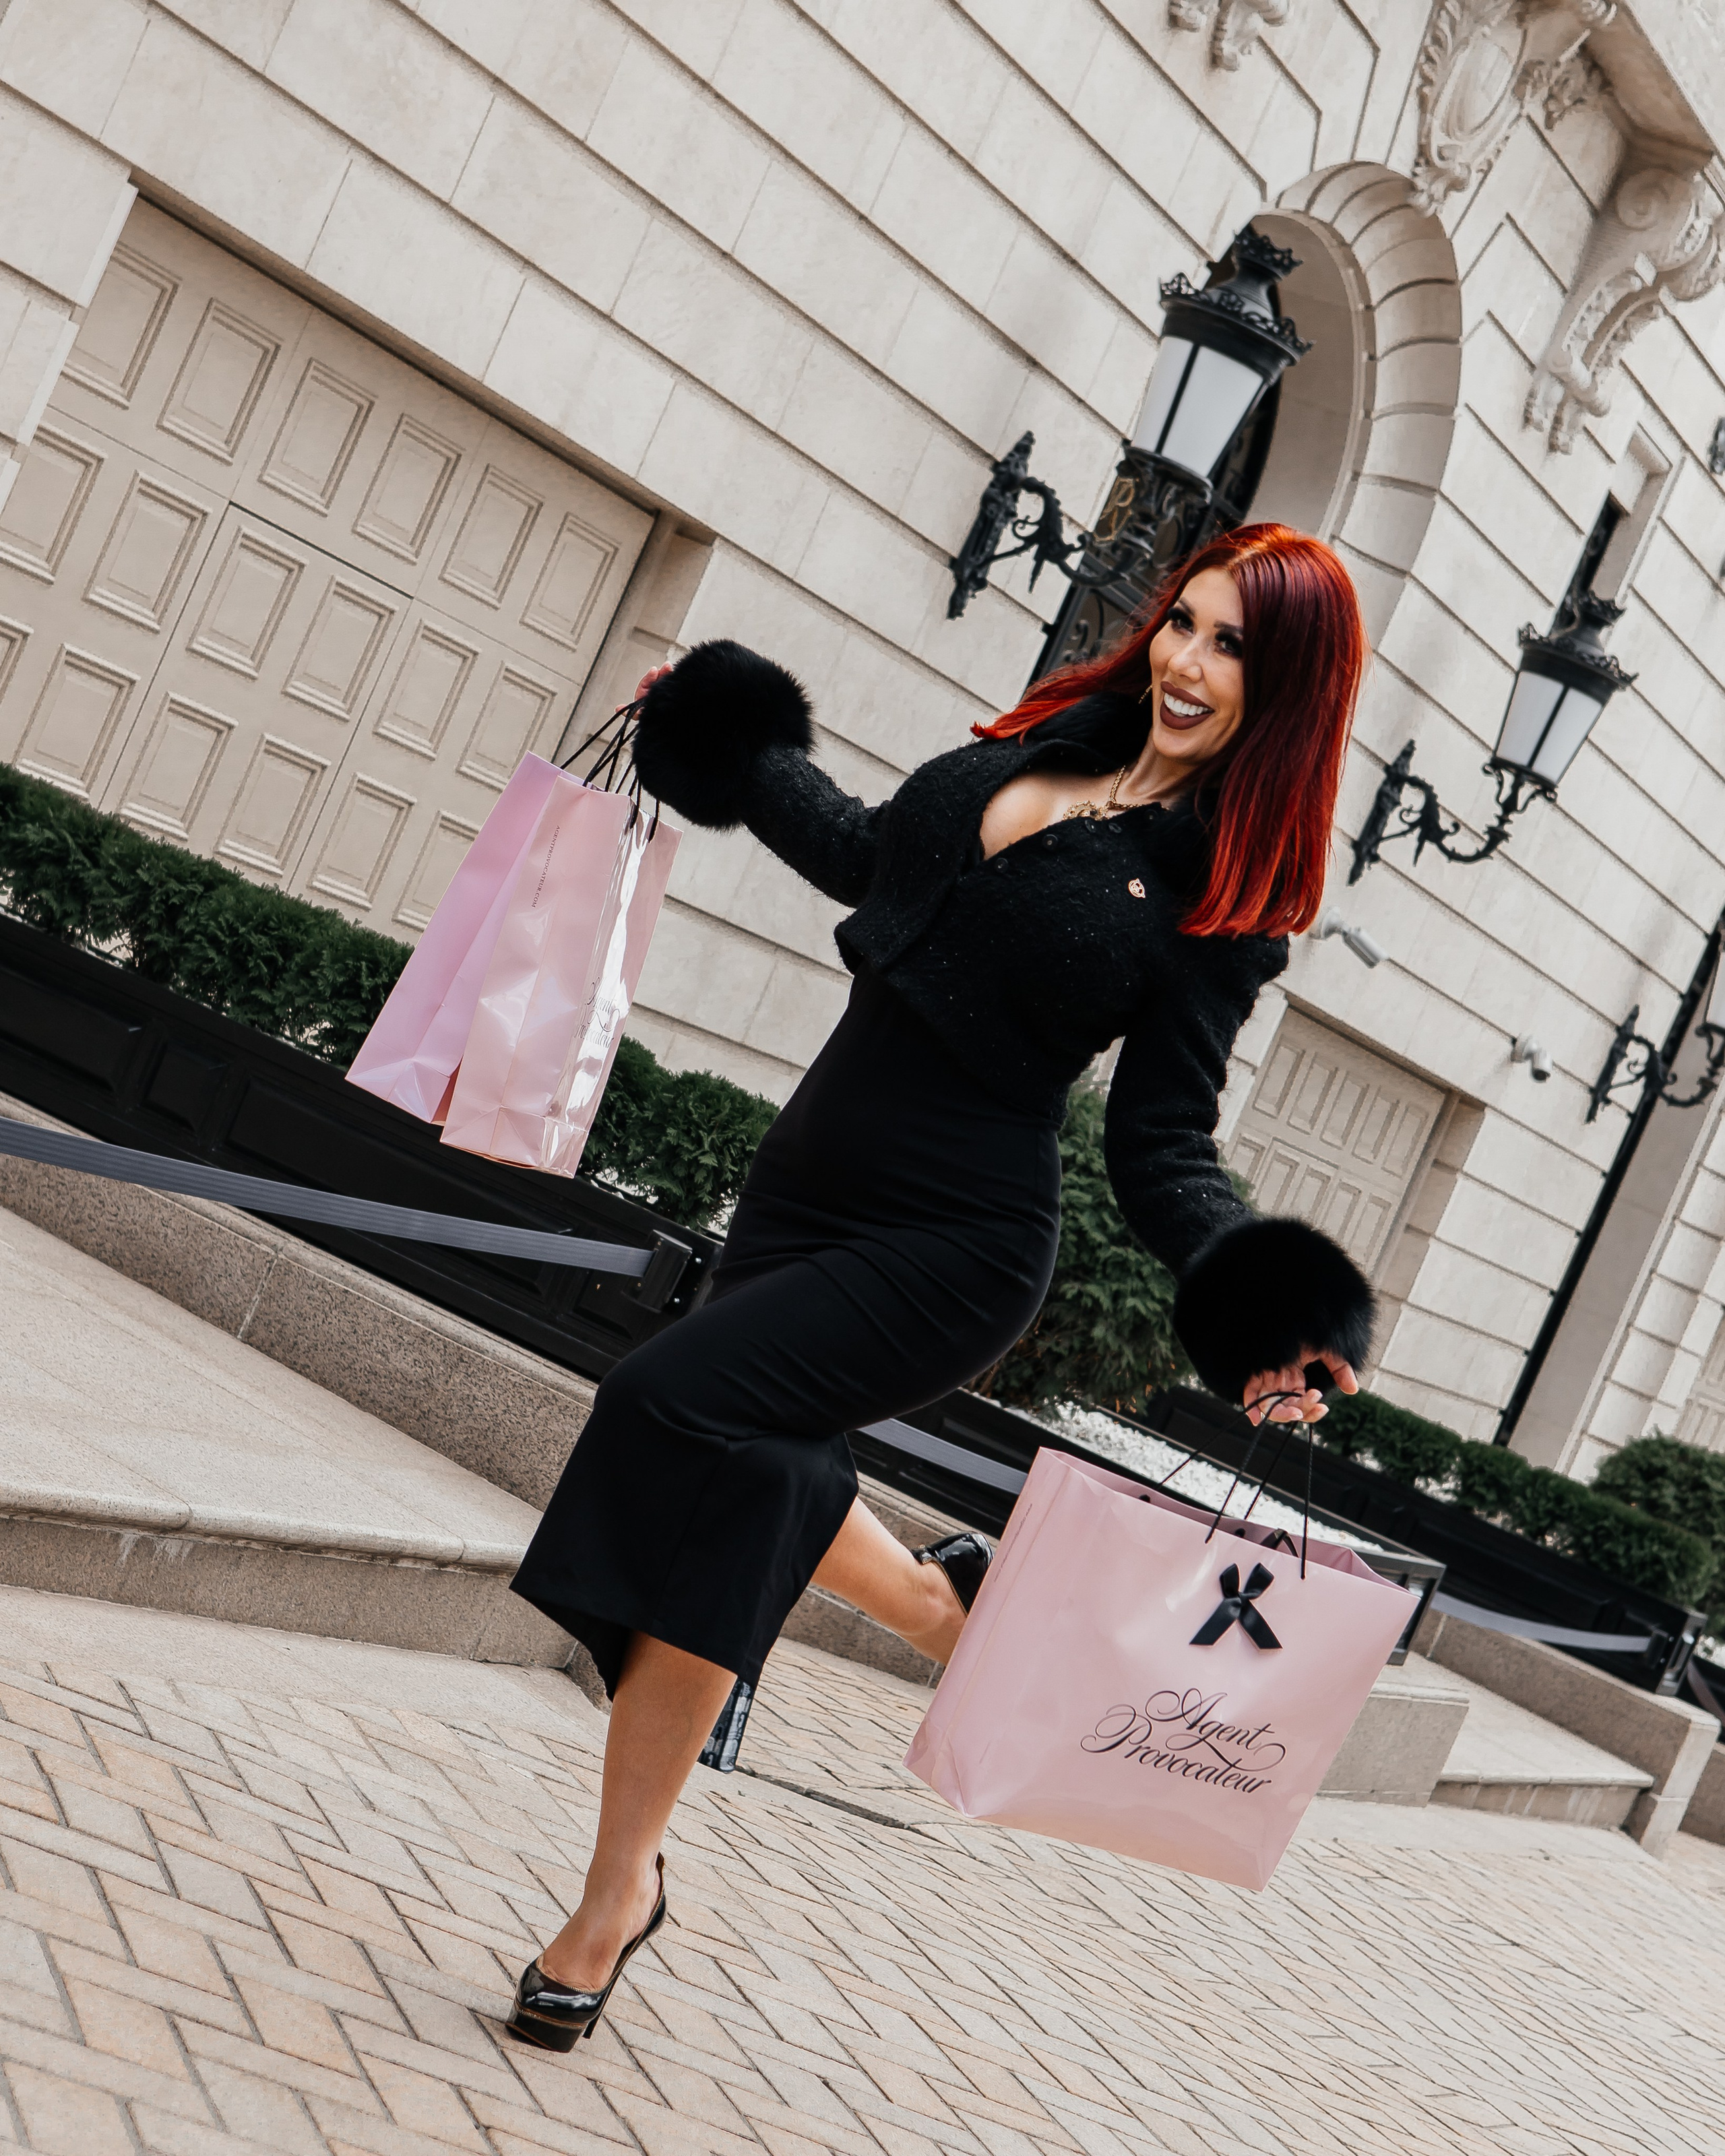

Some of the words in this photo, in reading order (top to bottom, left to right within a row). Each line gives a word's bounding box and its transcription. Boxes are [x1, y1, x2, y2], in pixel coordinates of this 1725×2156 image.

[531, 825, 561, 908] AGENTPROVOCATEUR.COM
[1080, 1703, 1272, 1793] Provocateur
[1145, 1687, 1286, 1772] Agent
